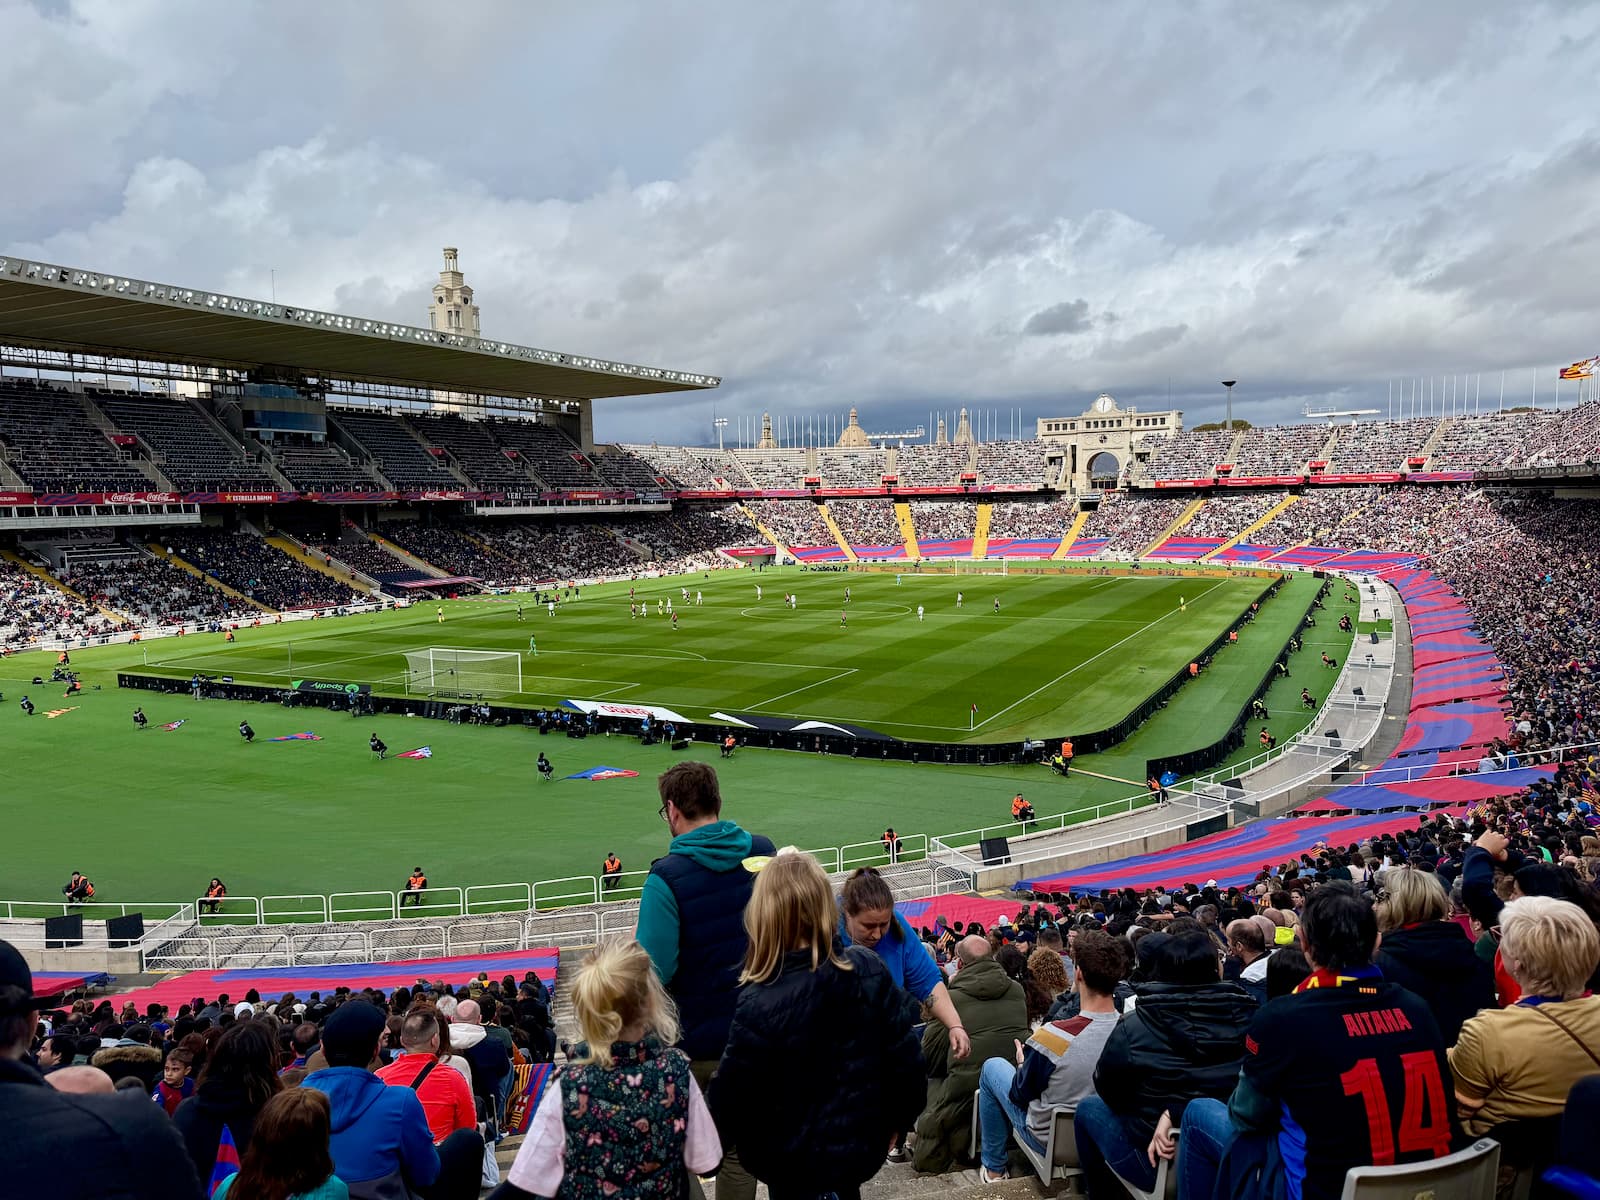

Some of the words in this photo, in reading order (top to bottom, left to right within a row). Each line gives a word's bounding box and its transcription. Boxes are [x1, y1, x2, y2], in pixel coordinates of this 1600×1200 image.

[310, 682, 345, 691] Spotify
[1342, 1007, 1413, 1037] AITANA
[1340, 1050, 1452, 1167] 14
